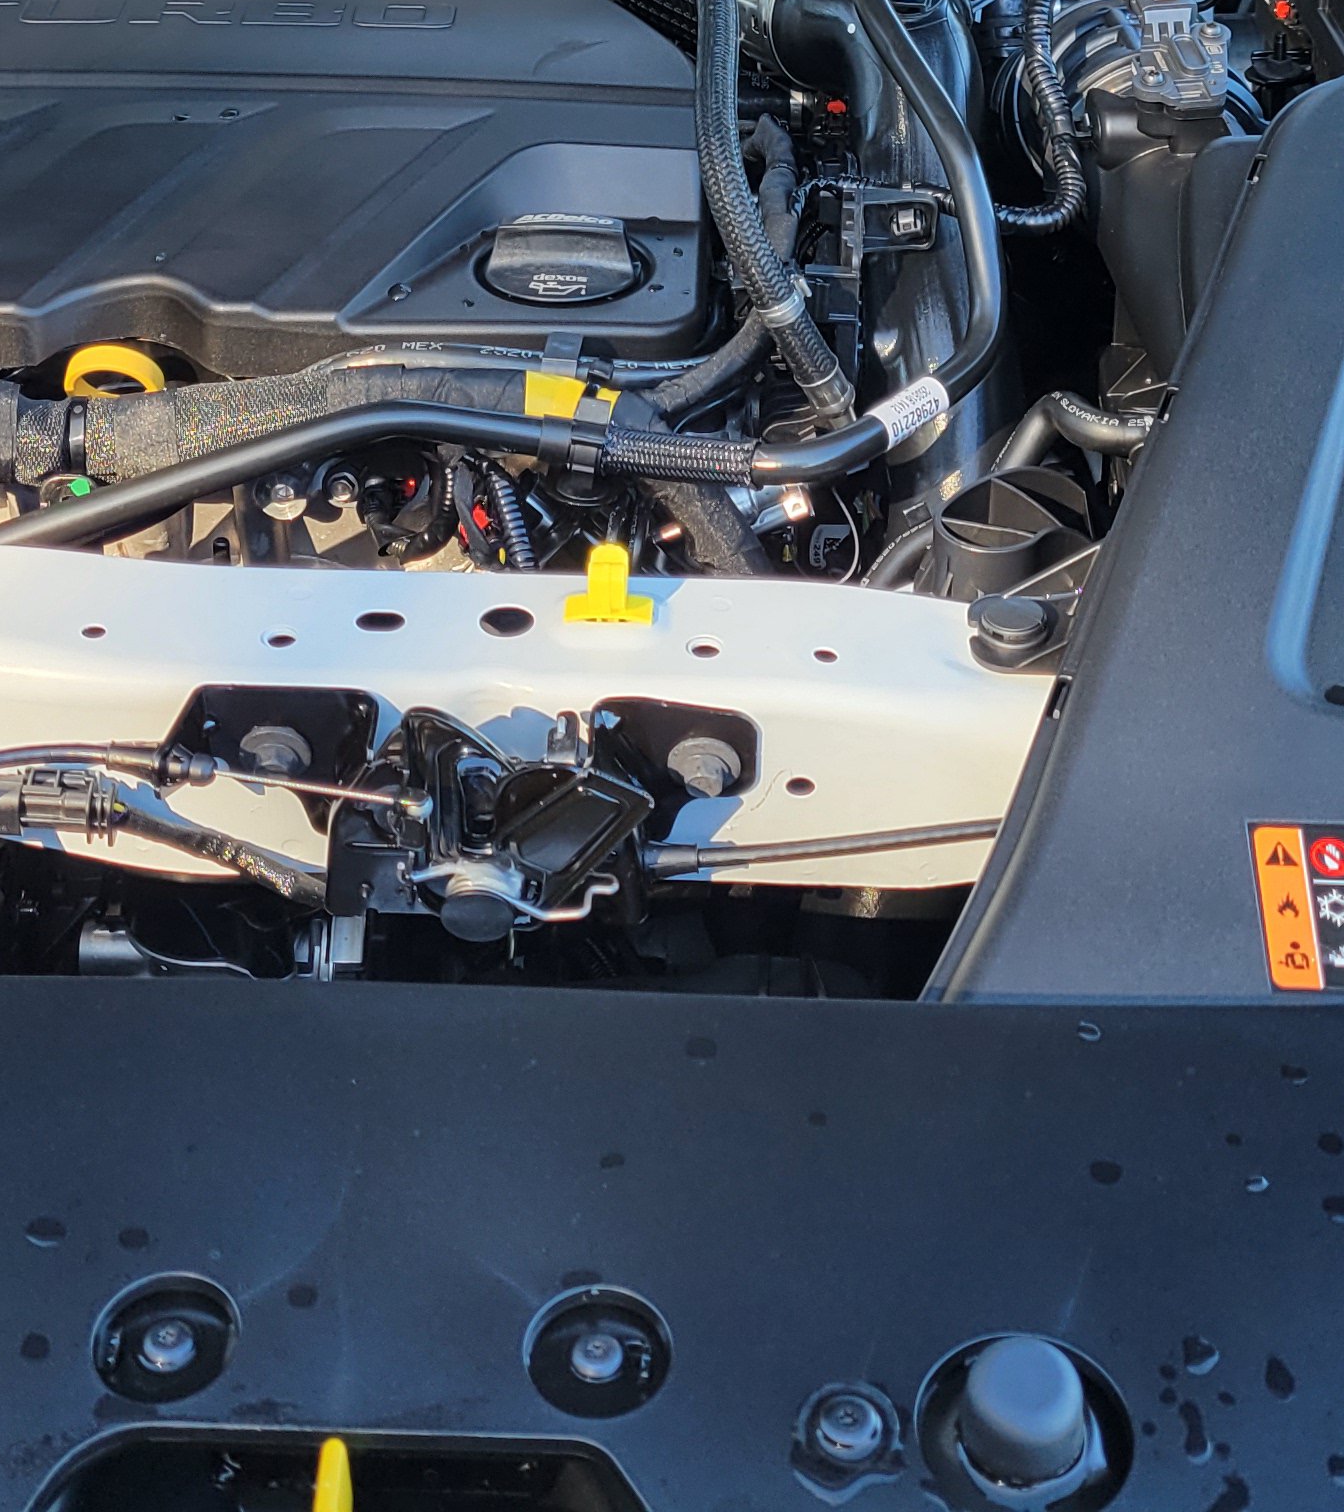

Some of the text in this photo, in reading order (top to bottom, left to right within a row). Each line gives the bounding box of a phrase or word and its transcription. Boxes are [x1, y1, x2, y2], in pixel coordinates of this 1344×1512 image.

[513, 213, 615, 226] ACDelco
[532, 273, 589, 284] dexos
[401, 341, 445, 352] MEX
[891, 397, 940, 438] 42982210
[1060, 397, 1120, 427] SLOVAKIA
